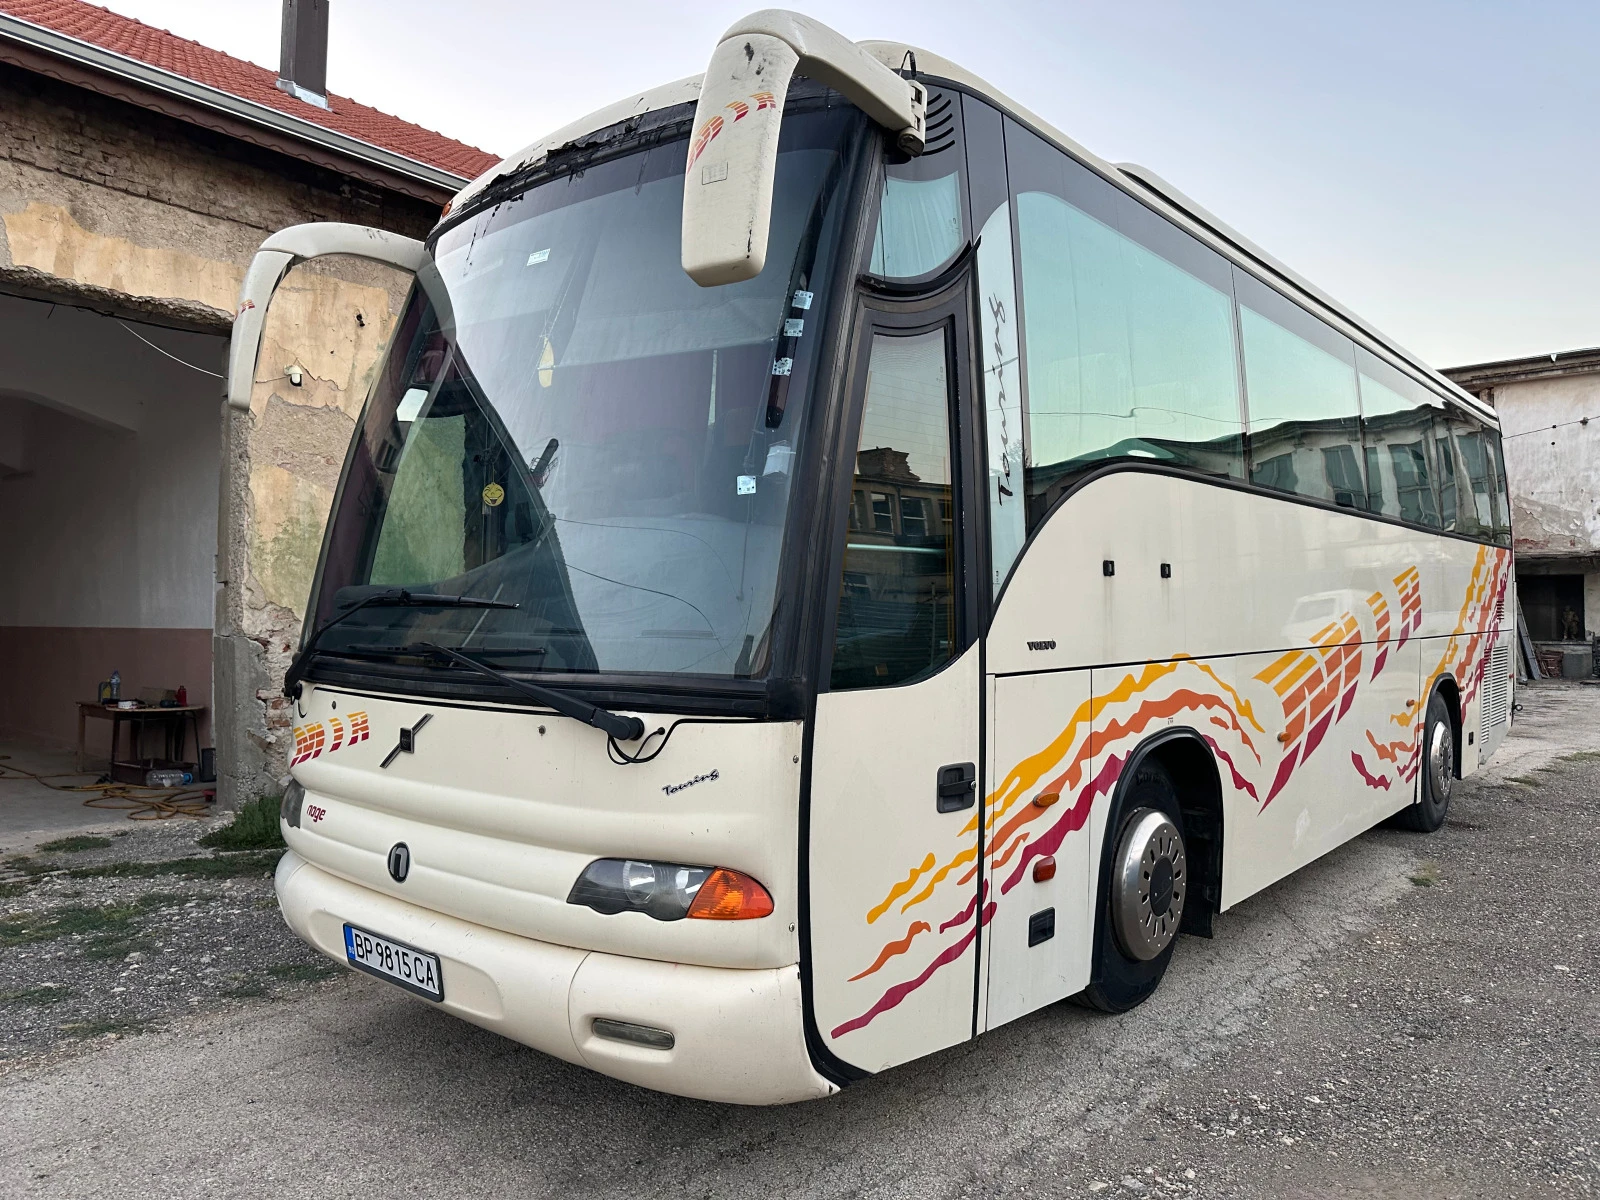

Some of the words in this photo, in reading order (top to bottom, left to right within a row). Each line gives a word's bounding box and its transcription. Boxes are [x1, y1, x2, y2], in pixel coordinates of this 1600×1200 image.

[988, 292, 1014, 507] Touring
[1026, 640, 1057, 651] VOLVO
[661, 768, 720, 796] Touring
[306, 804, 327, 823] noge
